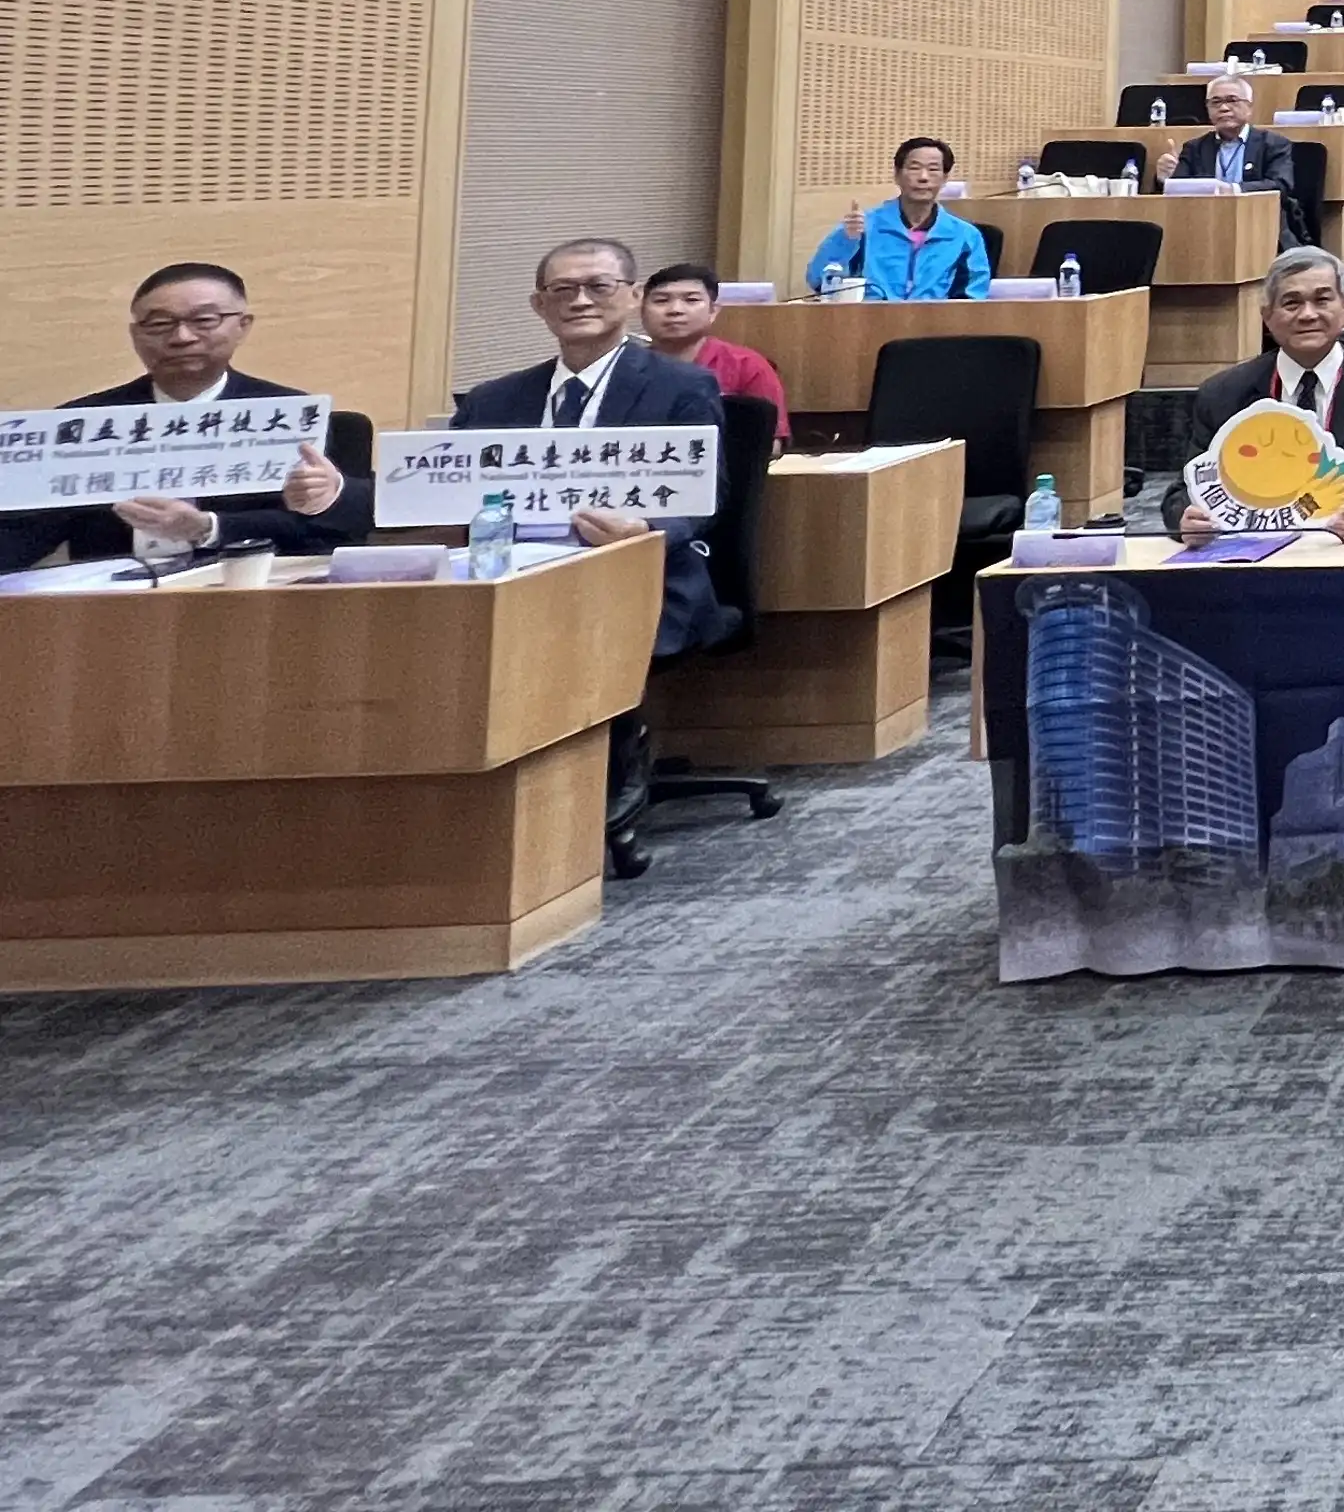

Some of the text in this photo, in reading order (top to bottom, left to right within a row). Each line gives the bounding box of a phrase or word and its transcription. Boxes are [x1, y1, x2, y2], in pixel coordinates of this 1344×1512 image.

[54, 403, 320, 445] 國立臺北科技大學
[403, 454, 471, 470] TAIPEI
[479, 438, 707, 469] 國立臺北科技大學
[49, 458, 300, 497] 電機工程系系友
[428, 472, 472, 484] TECH
